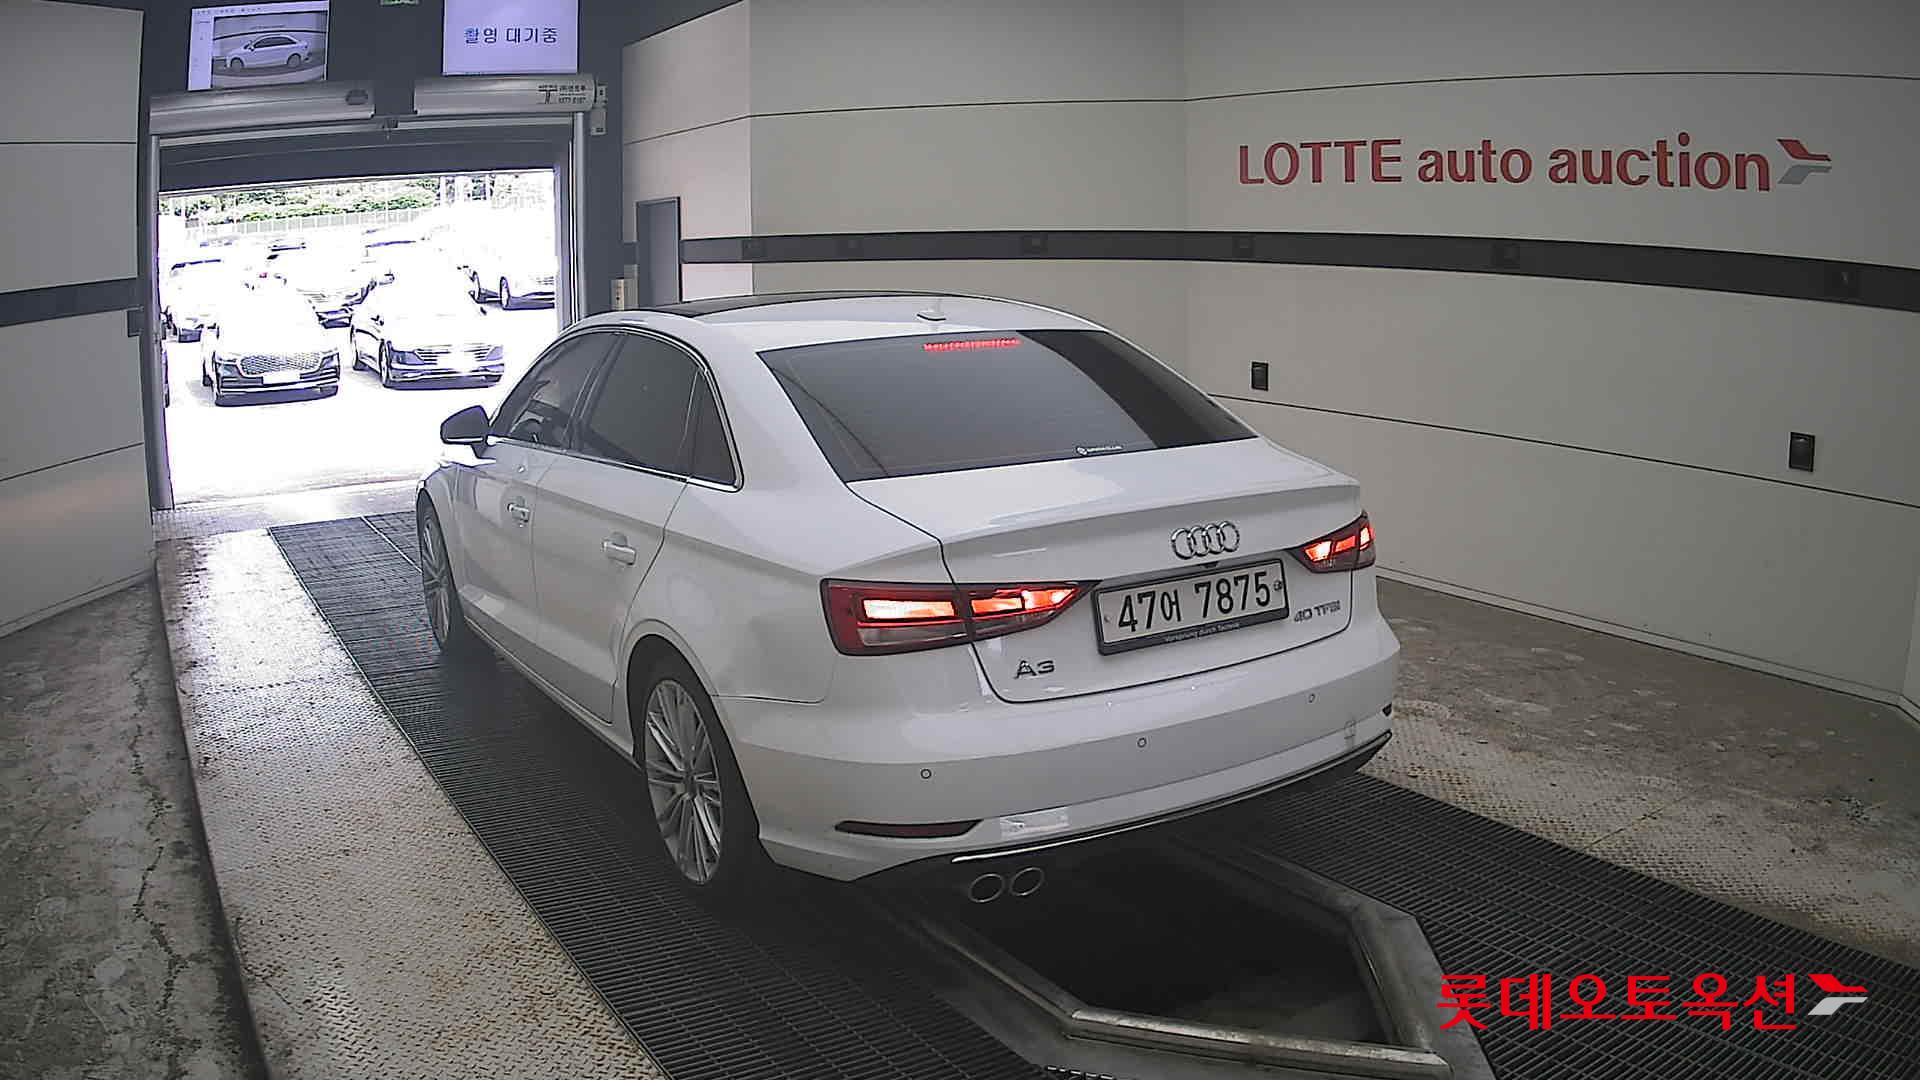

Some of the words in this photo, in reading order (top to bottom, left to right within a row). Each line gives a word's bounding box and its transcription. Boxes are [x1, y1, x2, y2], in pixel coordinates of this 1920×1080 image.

[506, 27, 557, 44] 대기중
[1238, 140, 1401, 185] LOTTE
[1418, 139, 1533, 184] auto
[1548, 132, 1770, 191] auction
[1118, 589, 1182, 632] 47어
[1194, 571, 1271, 618] 7875
[1014, 660, 1054, 679] A3
